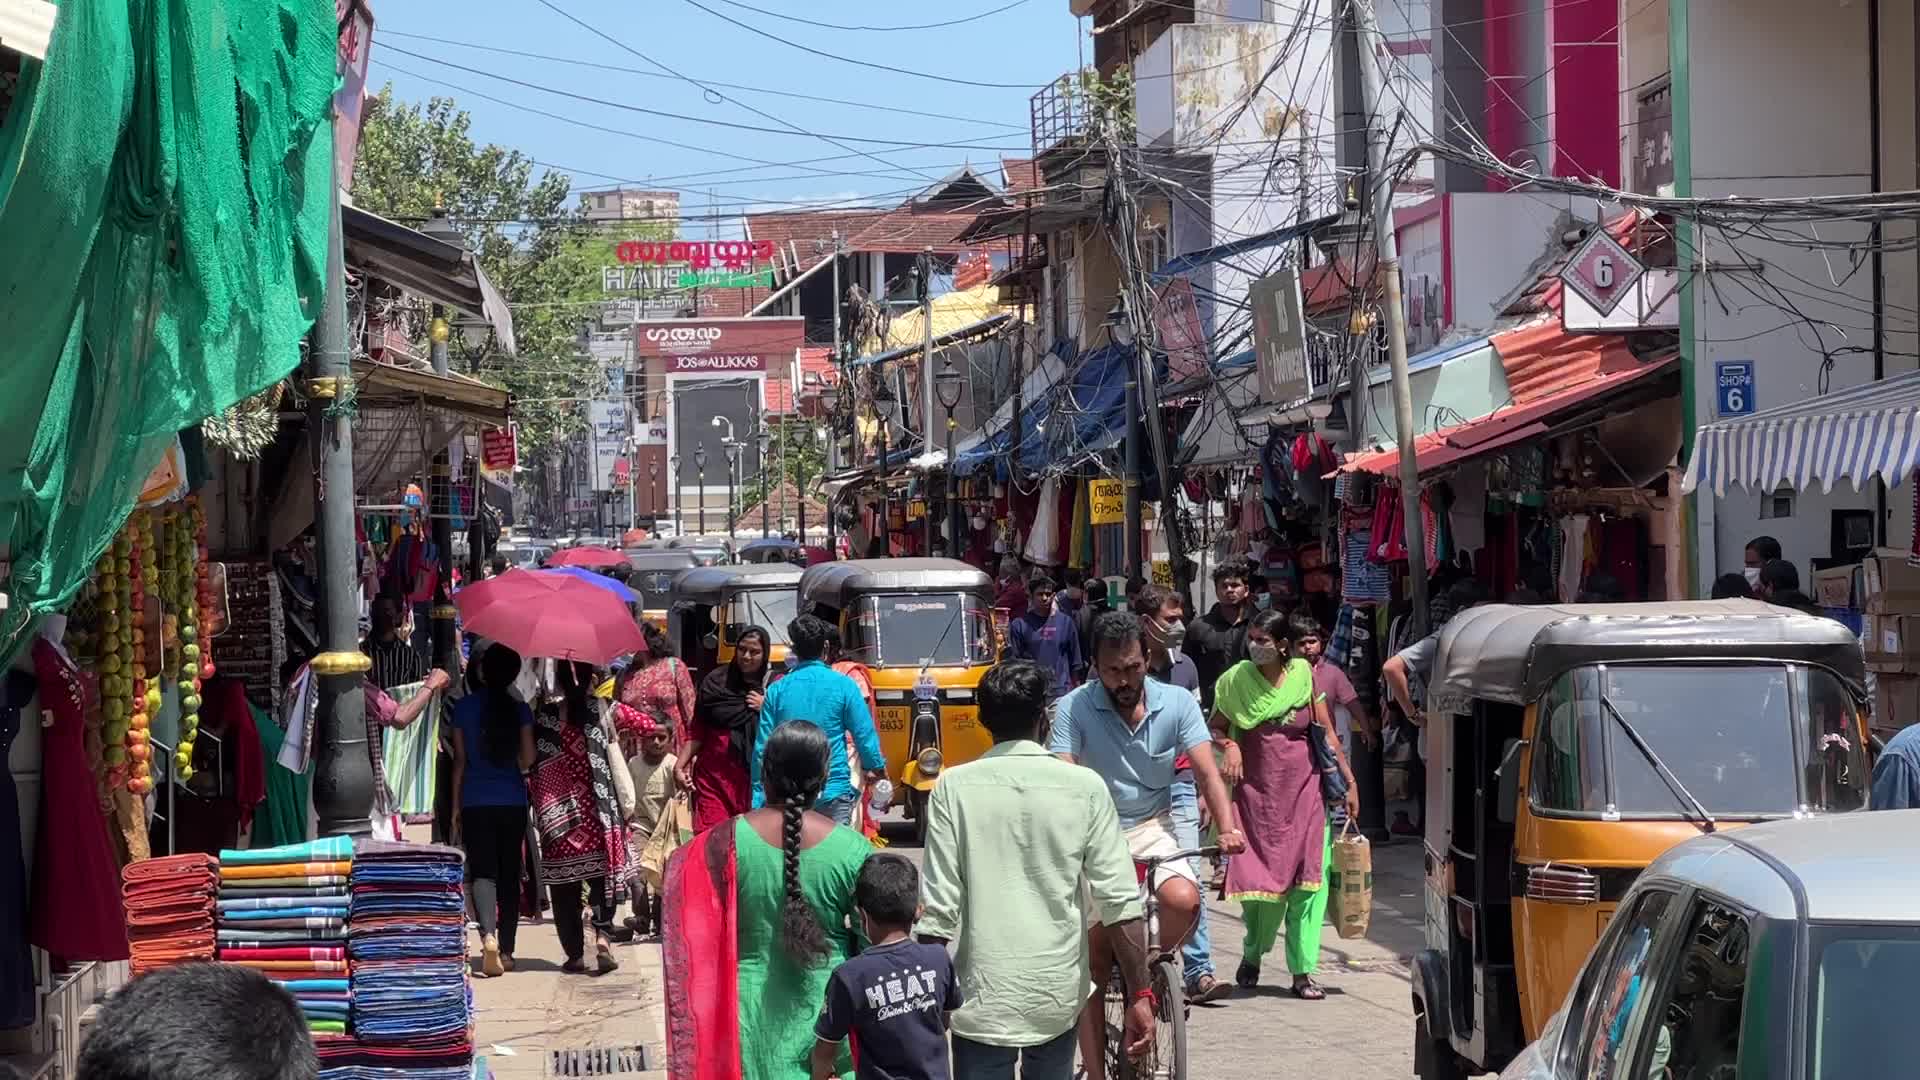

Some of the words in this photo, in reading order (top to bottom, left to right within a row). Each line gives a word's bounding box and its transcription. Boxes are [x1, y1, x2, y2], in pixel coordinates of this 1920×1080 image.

[1593, 255, 1614, 288] 6
[676, 357, 697, 369] JOS
[708, 356, 758, 369] ALUKKAS
[1727, 388, 1744, 412] 6
[865, 970, 936, 1009] HEAT
